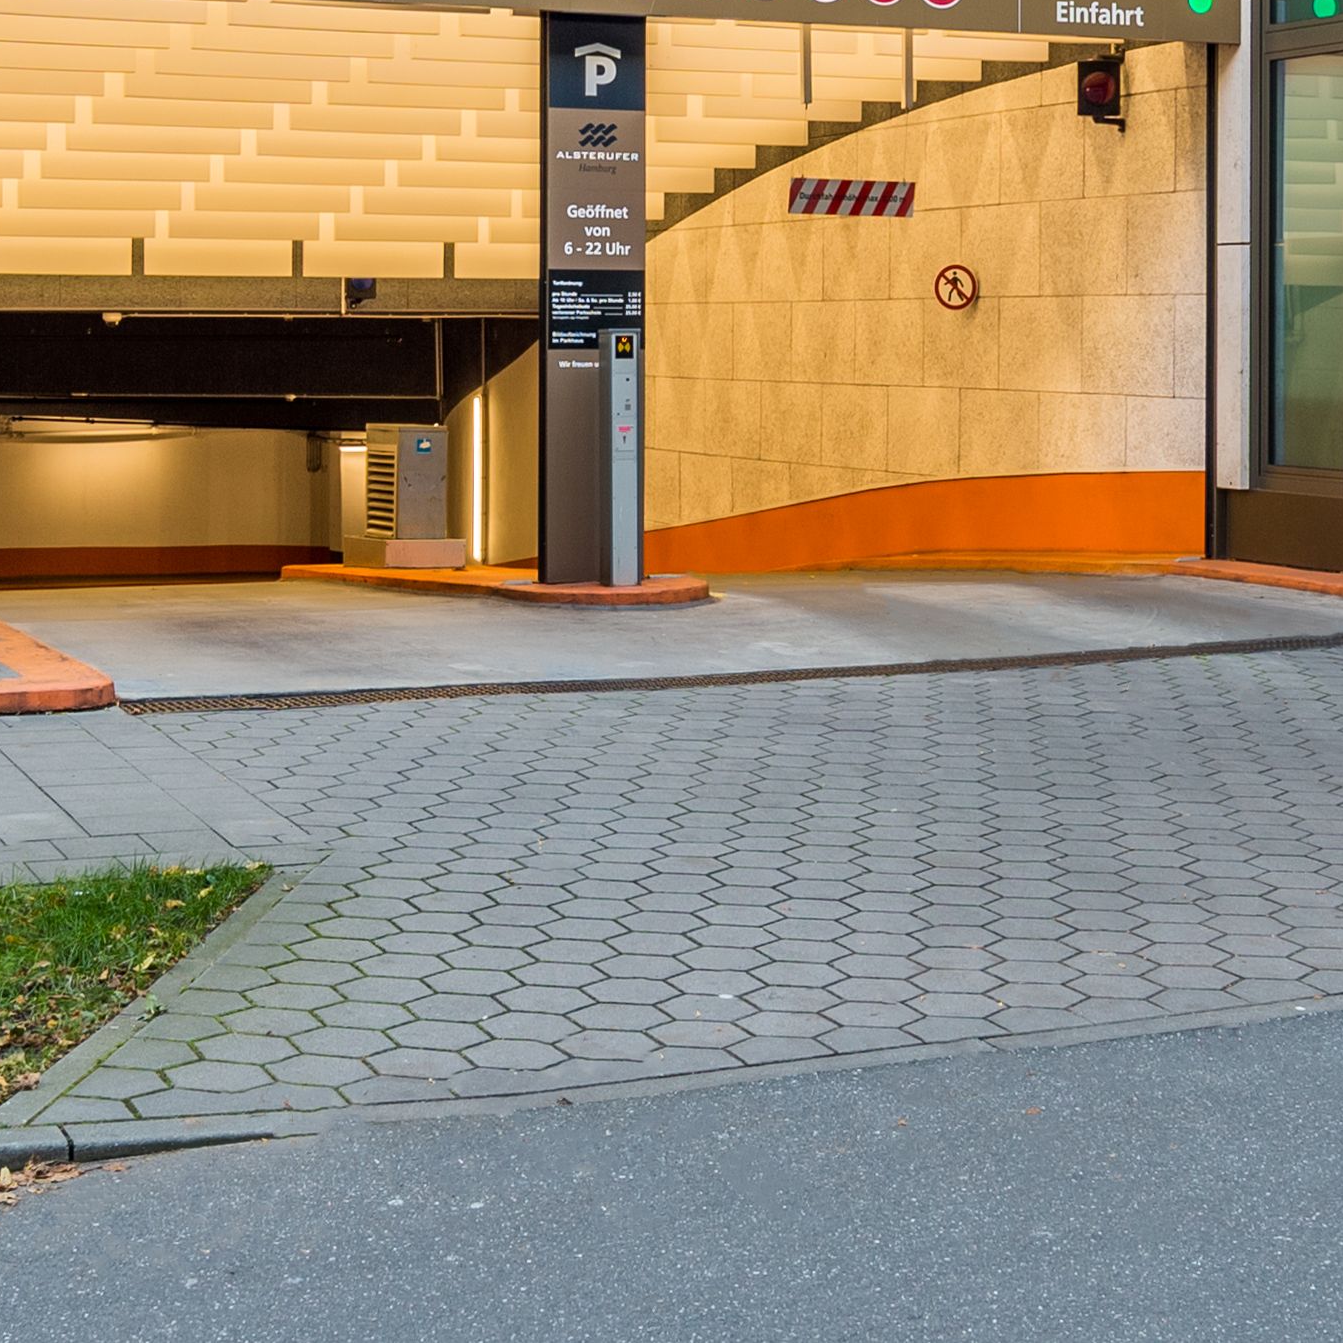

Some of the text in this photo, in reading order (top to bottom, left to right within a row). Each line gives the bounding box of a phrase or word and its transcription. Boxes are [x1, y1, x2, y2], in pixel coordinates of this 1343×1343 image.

[1055, 1, 1144, 28] Einfahrt
[584, 56, 617, 97] P
[556, 151, 639, 162] ALSTERUFER
[578, 163, 617, 175] Hamburg
[566, 204, 629, 219] Geöffnet
[584, 224, 611, 238] von
[564, 242, 573, 255] 6
[585, 242, 602, 255] 22
[605, 241, 631, 256] Uhr
[558, 360, 571, 368] Wir
[571, 360, 594, 368] freuen
